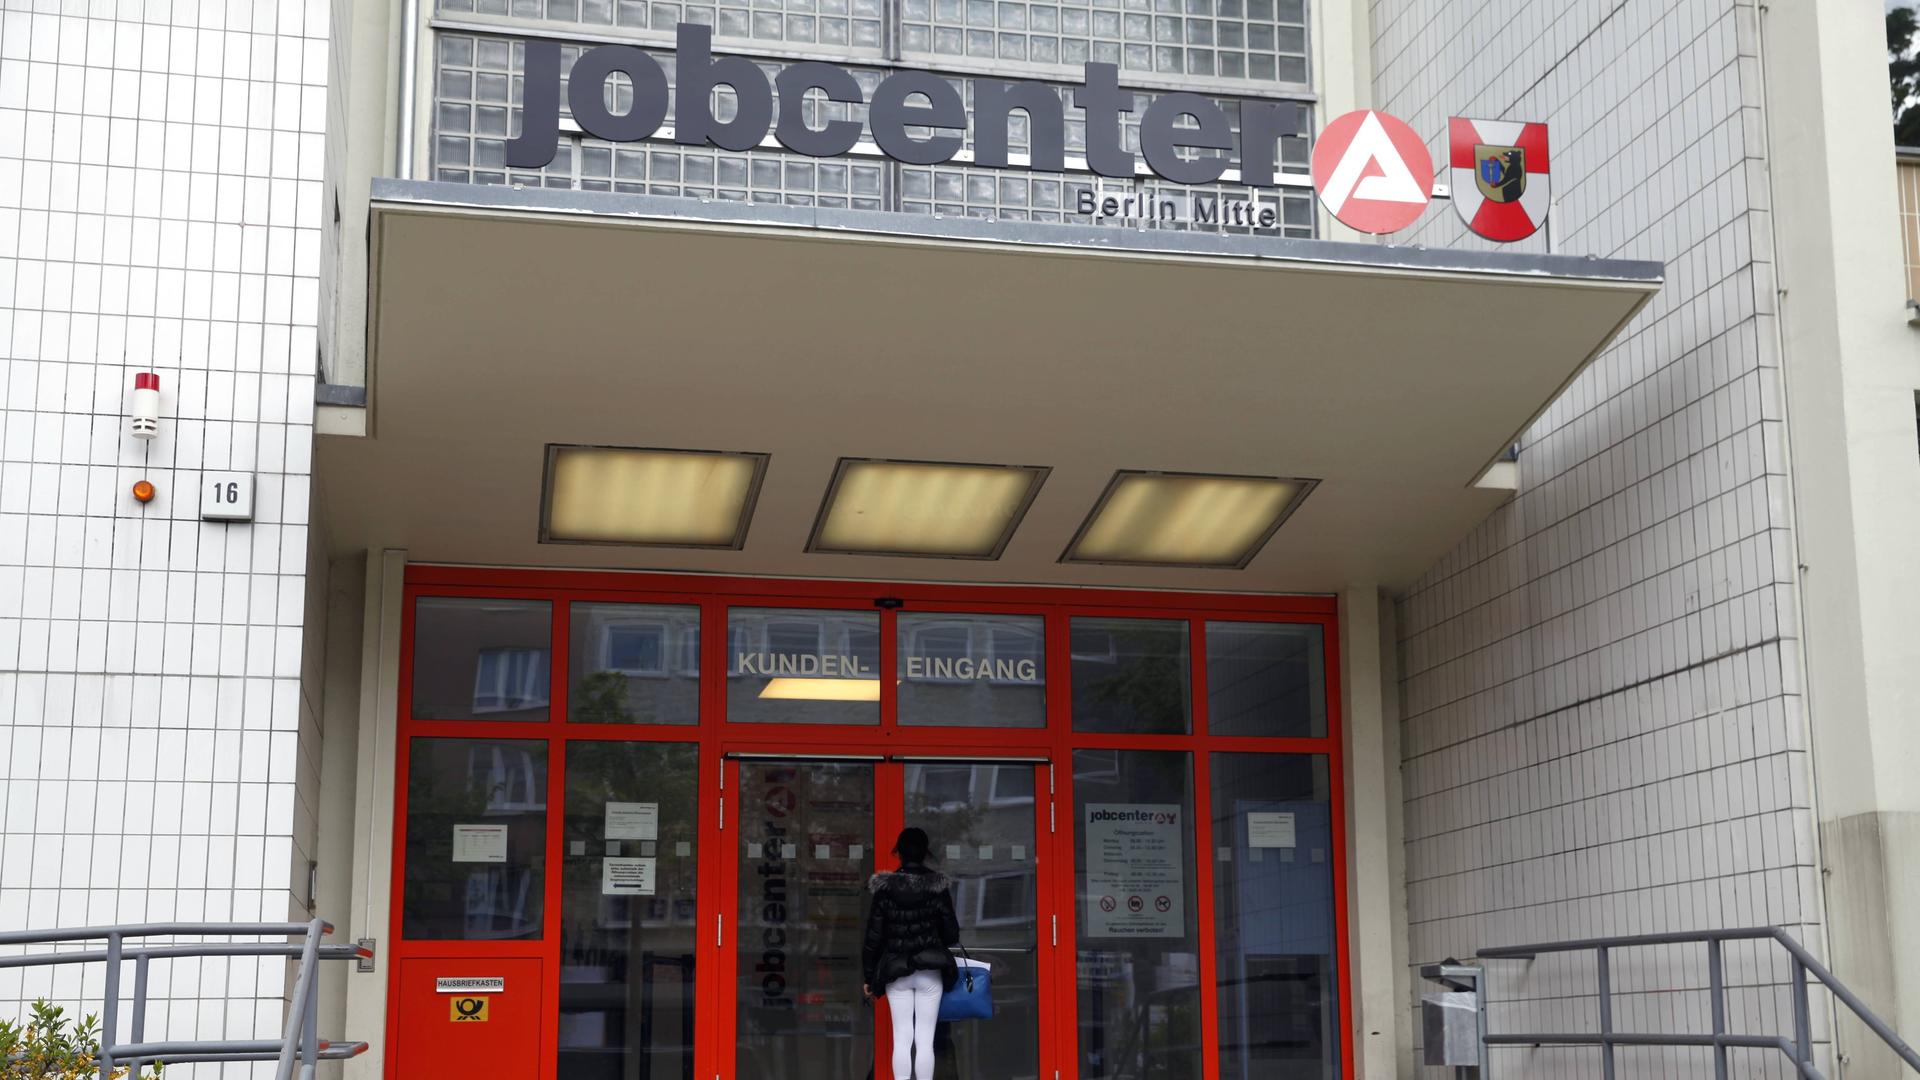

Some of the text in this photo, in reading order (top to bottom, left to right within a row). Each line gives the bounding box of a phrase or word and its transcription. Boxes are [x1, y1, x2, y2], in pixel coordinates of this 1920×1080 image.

[507, 22, 1299, 187] jobcenter
[1077, 188, 1277, 228] Berlin Mitte
[214, 481, 239, 504] 16
[738, 651, 1037, 682] KUNDEN- EINGANG
[1090, 809, 1154, 823] jobcenter
[755, 820, 792, 1009] jobcenter
[438, 979, 503, 987] HAUSBRIEFKASTEN
